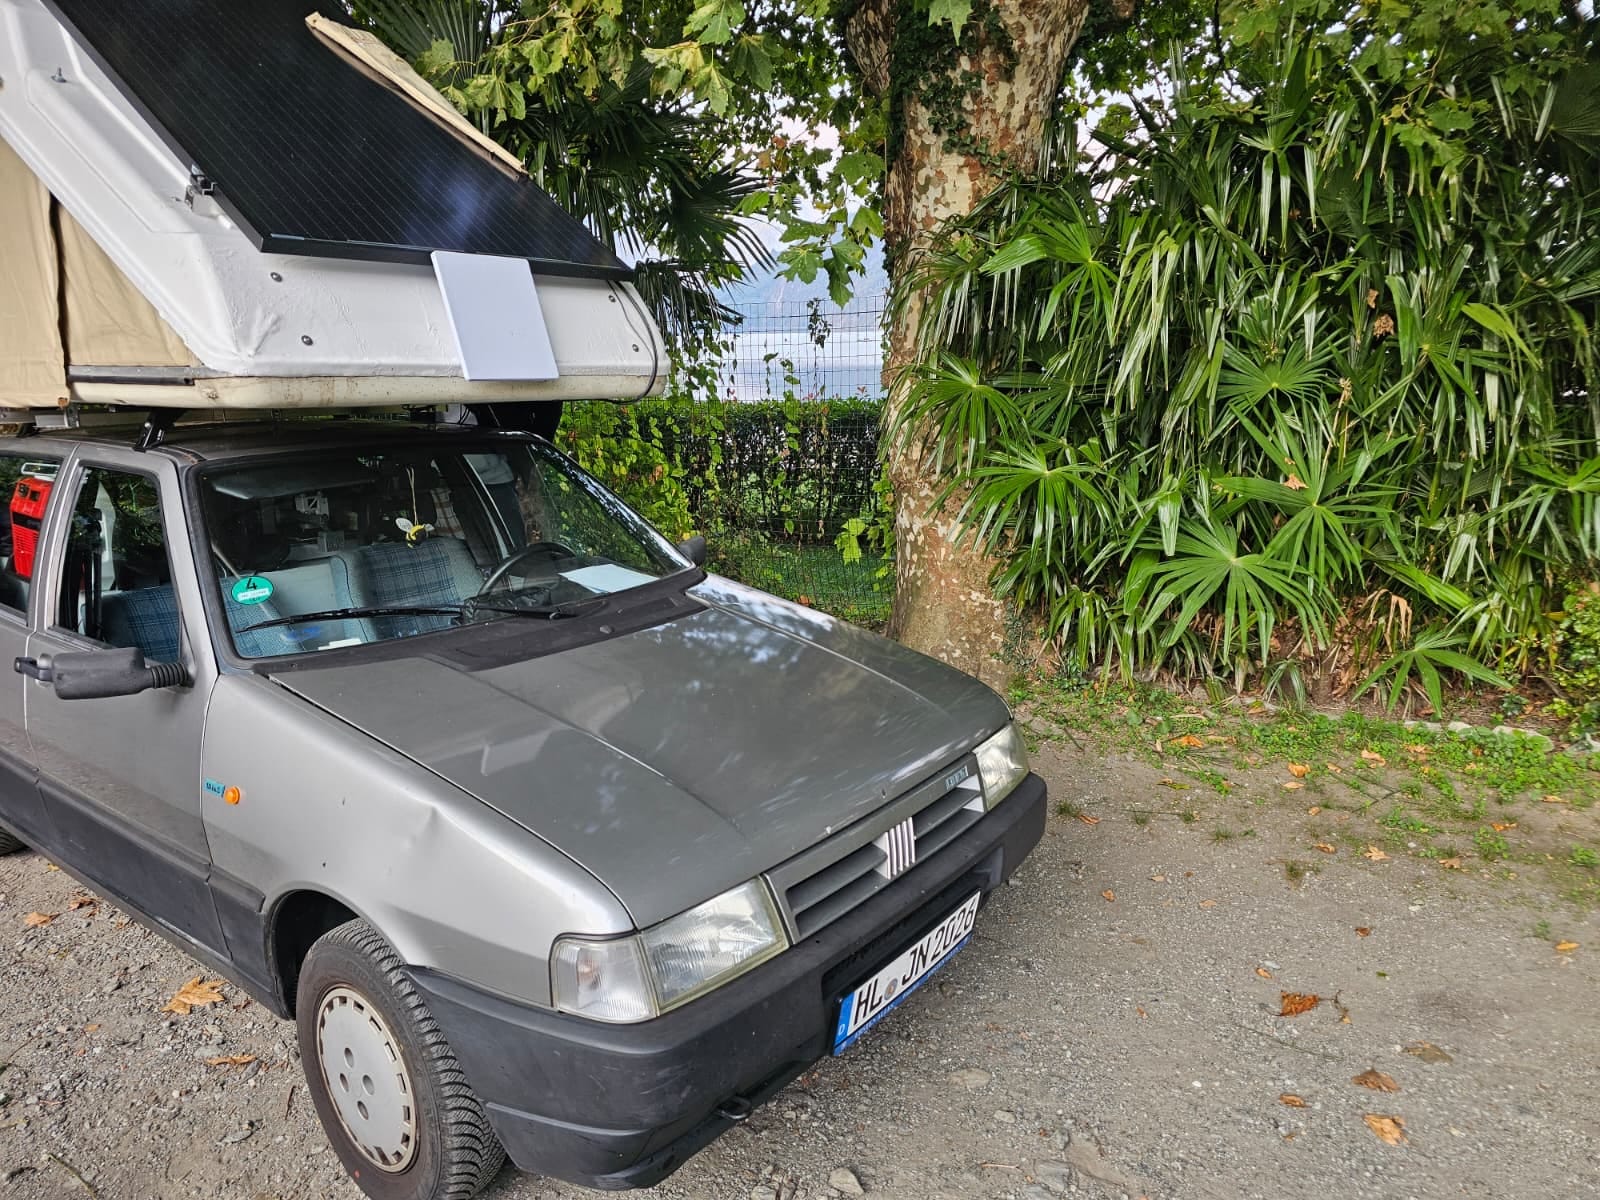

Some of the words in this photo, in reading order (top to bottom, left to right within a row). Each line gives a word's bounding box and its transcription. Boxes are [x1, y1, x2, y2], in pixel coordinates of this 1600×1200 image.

[246, 577, 257, 590] 4
[853, 978, 883, 1026] HL
[902, 936, 931, 986] JN
[931, 897, 976, 960] 2026
